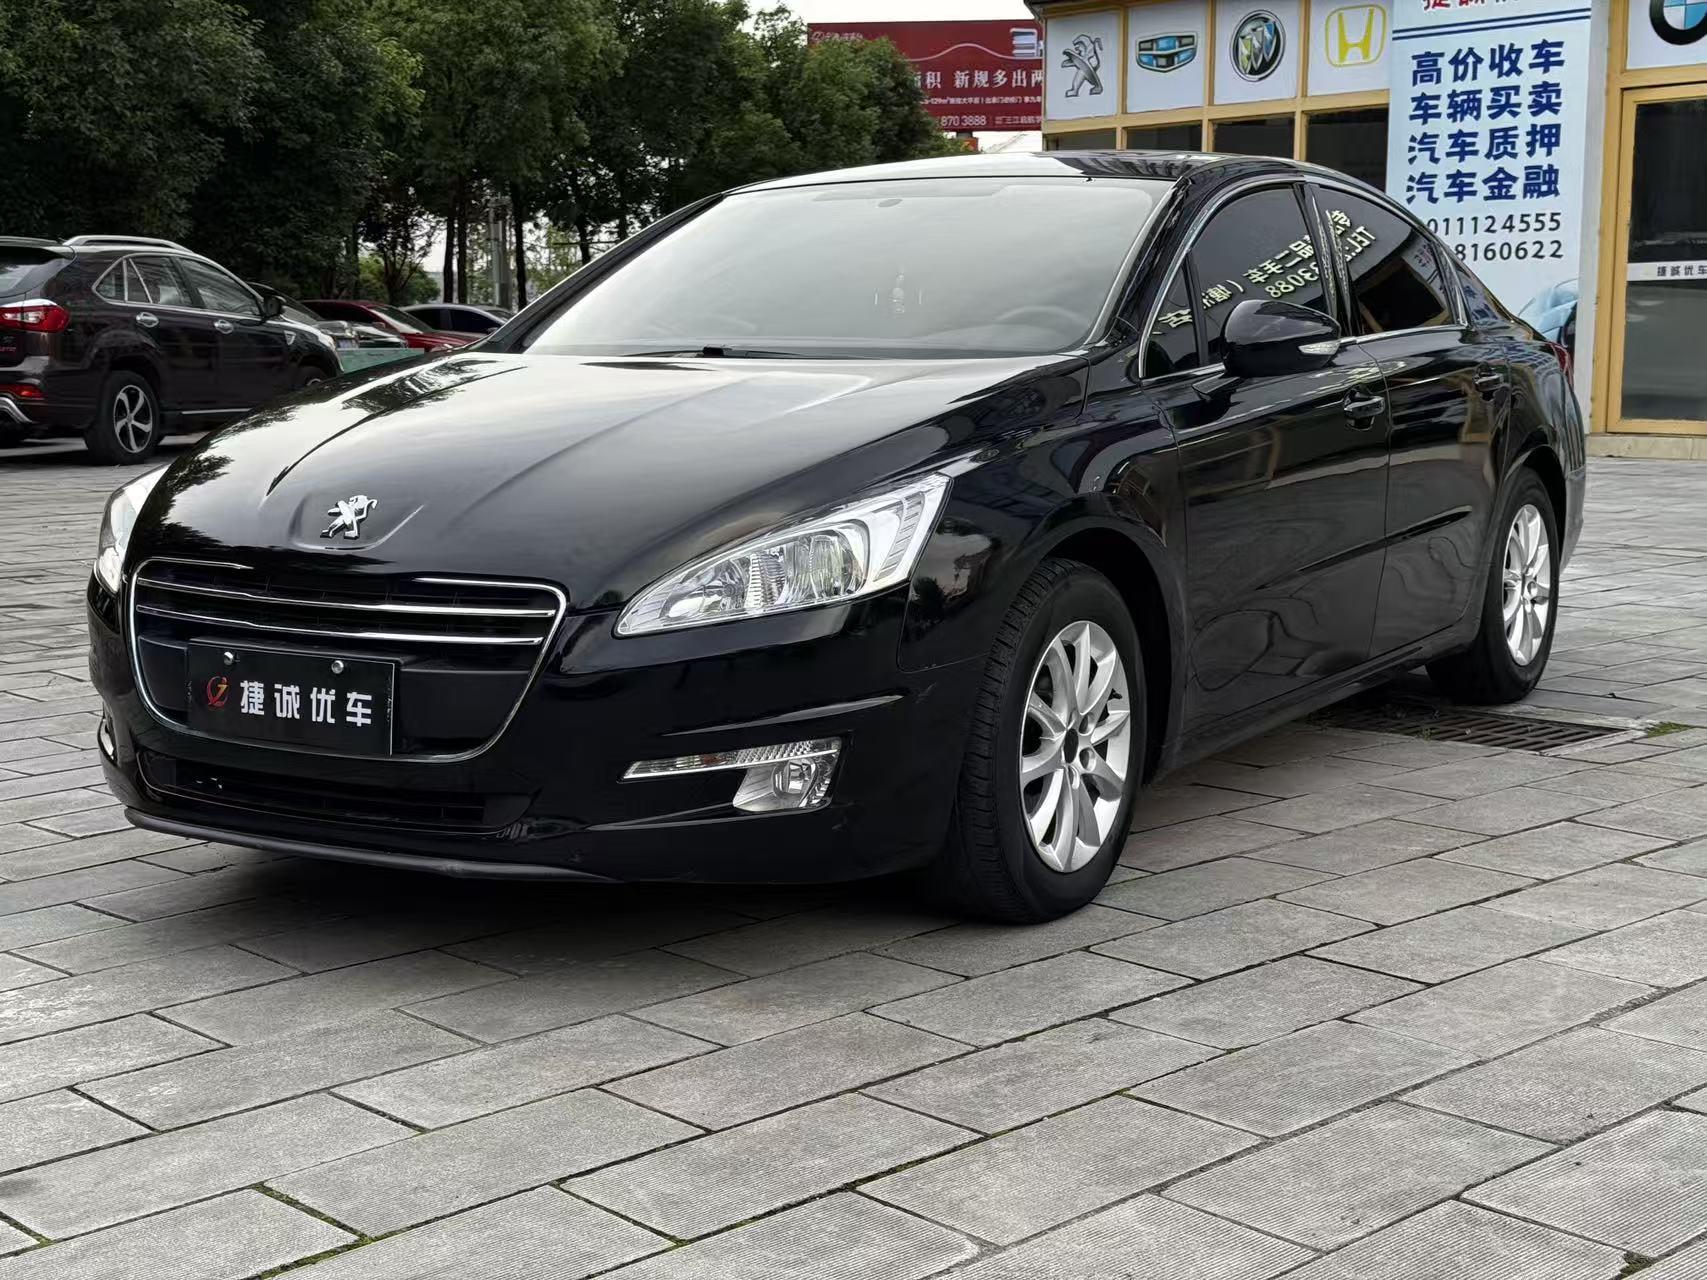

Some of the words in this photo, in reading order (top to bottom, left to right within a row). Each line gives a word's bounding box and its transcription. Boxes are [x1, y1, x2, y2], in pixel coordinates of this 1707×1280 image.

[1410, 38, 1566, 88] 高价收车
[940, 115, 960, 127] 870
[960, 114, 987, 127] 3888
[1408, 81, 1563, 126] 车辆买卖
[1406, 123, 1562, 165] 汽车质押
[1405, 163, 1560, 205] 汽车金融
[239, 679, 373, 727] 捷诚优车
